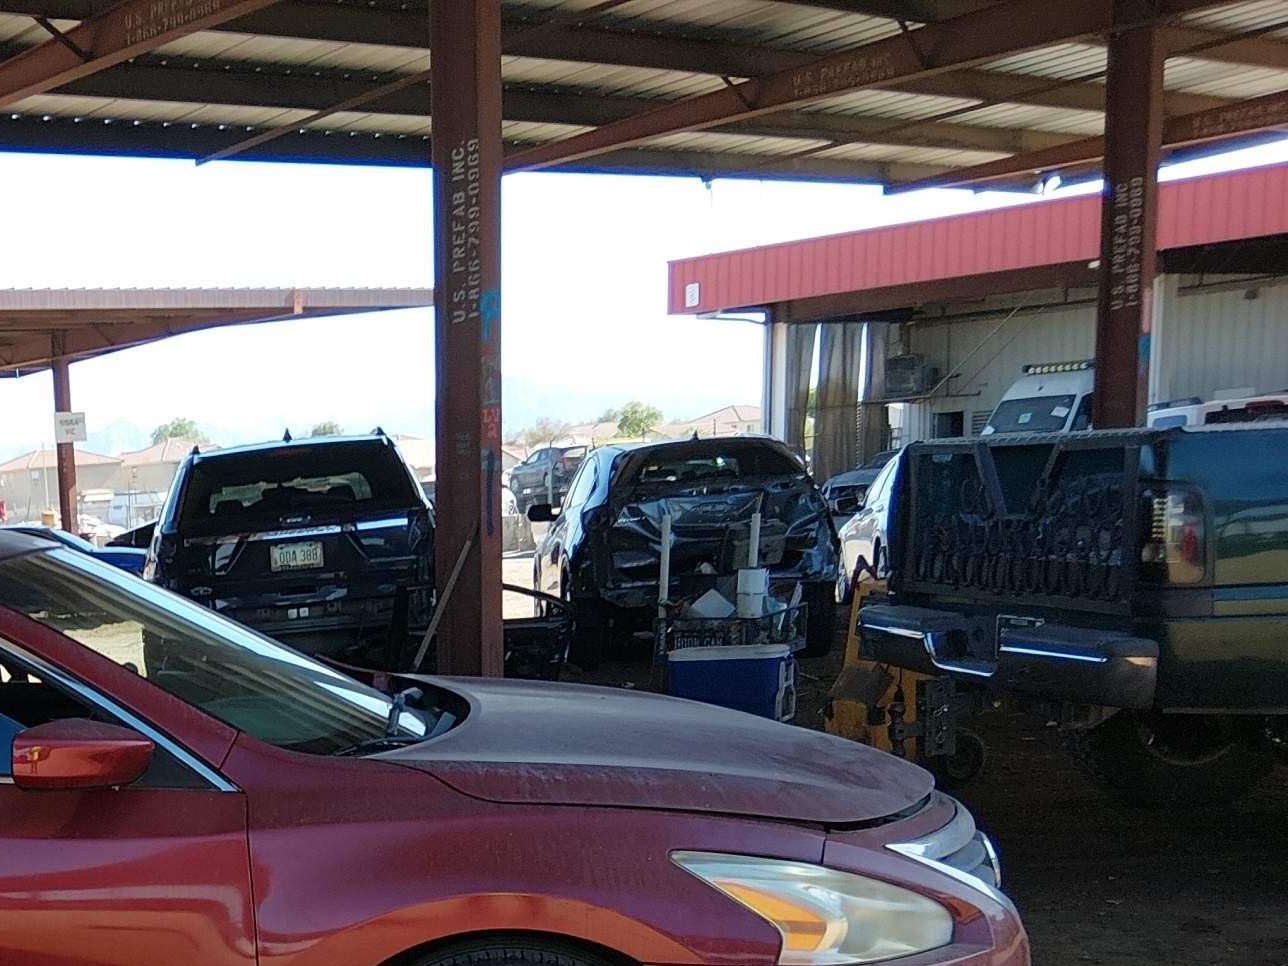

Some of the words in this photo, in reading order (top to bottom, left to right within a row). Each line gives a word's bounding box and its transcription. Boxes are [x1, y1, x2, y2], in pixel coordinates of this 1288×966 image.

[452, 140, 465, 182] INC.
[453, 191, 466, 273] PREFAB
[467, 138, 480, 319] 1-866-799-0969
